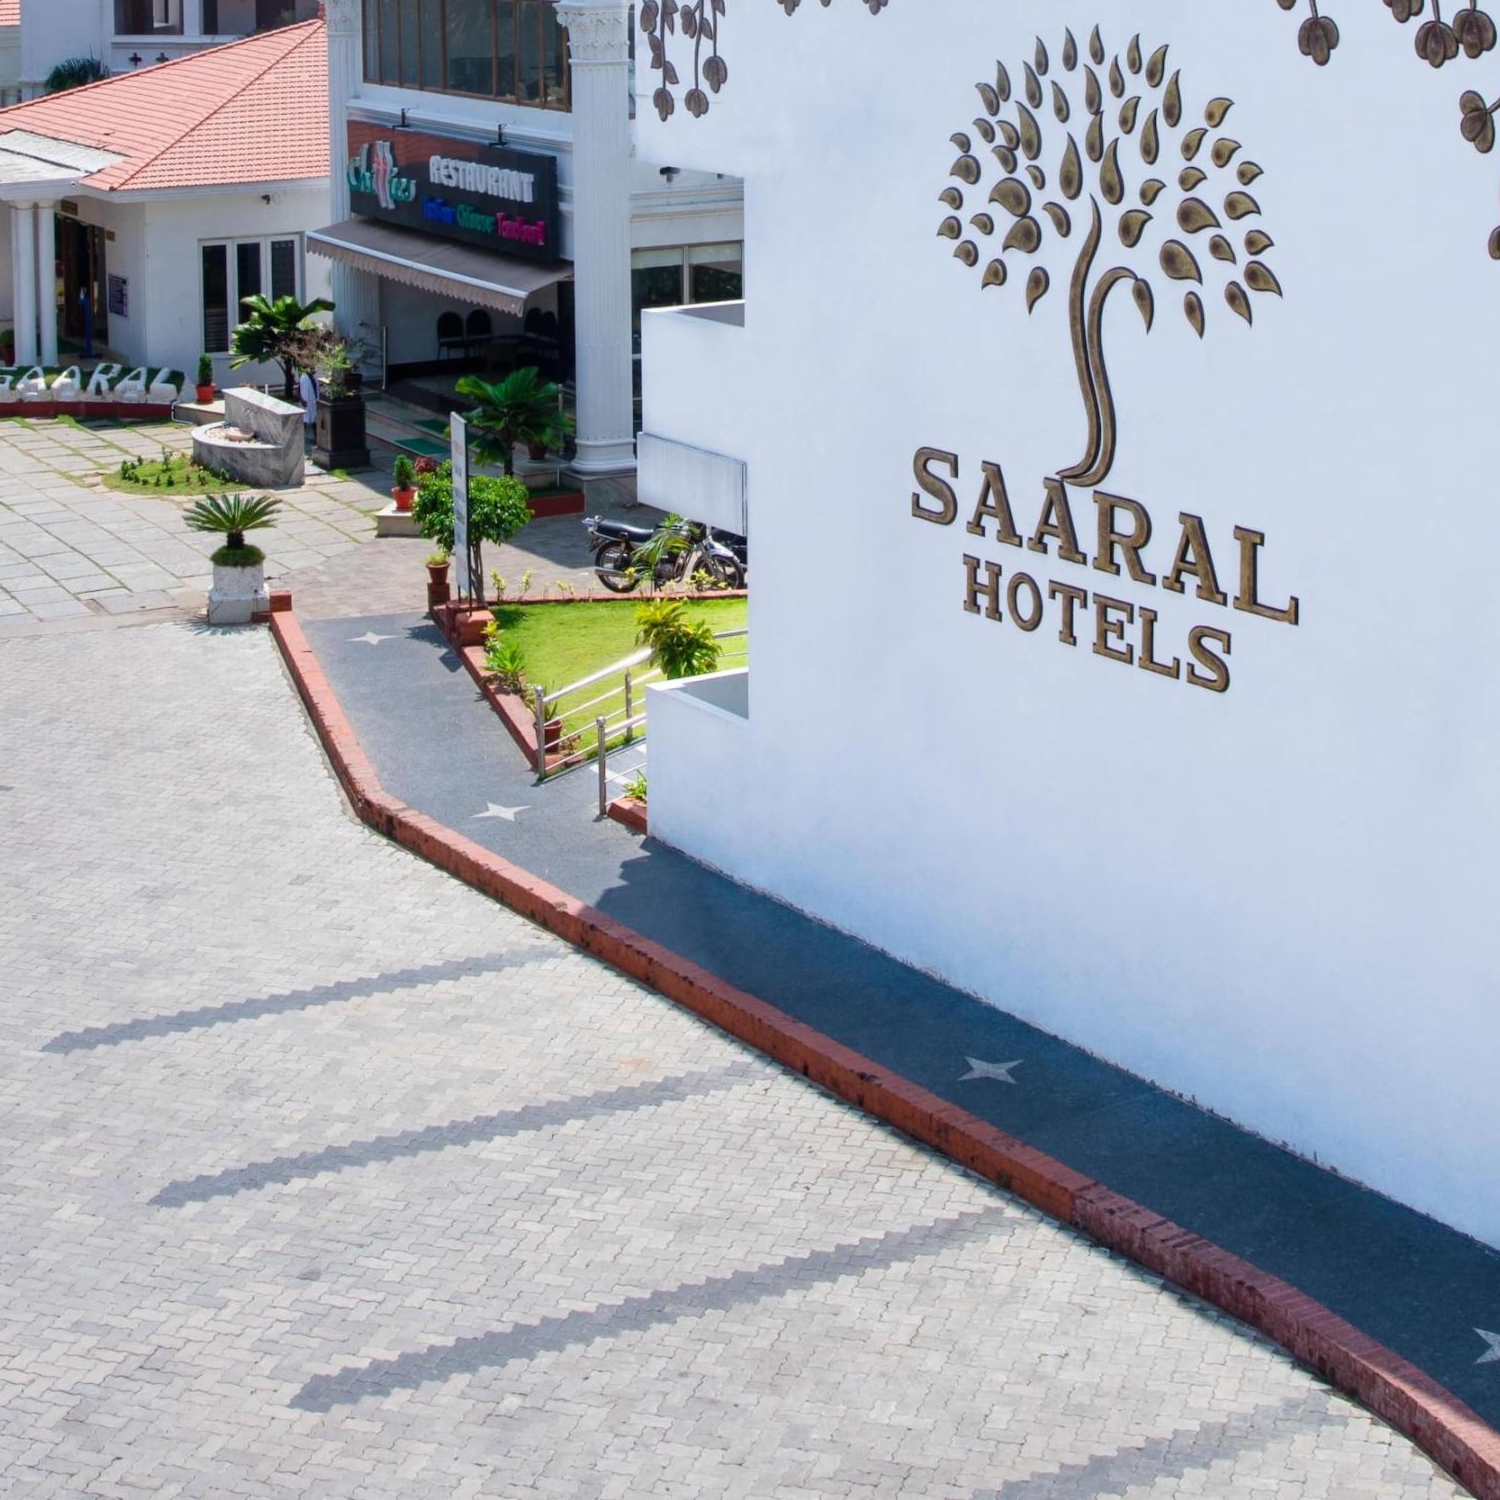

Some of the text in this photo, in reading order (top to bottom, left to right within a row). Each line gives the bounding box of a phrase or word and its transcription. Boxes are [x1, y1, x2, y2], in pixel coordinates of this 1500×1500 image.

[429, 155, 535, 203] RESTAURANT
[911, 446, 1300, 626] SAARAL
[962, 552, 1232, 693] HOTELS
